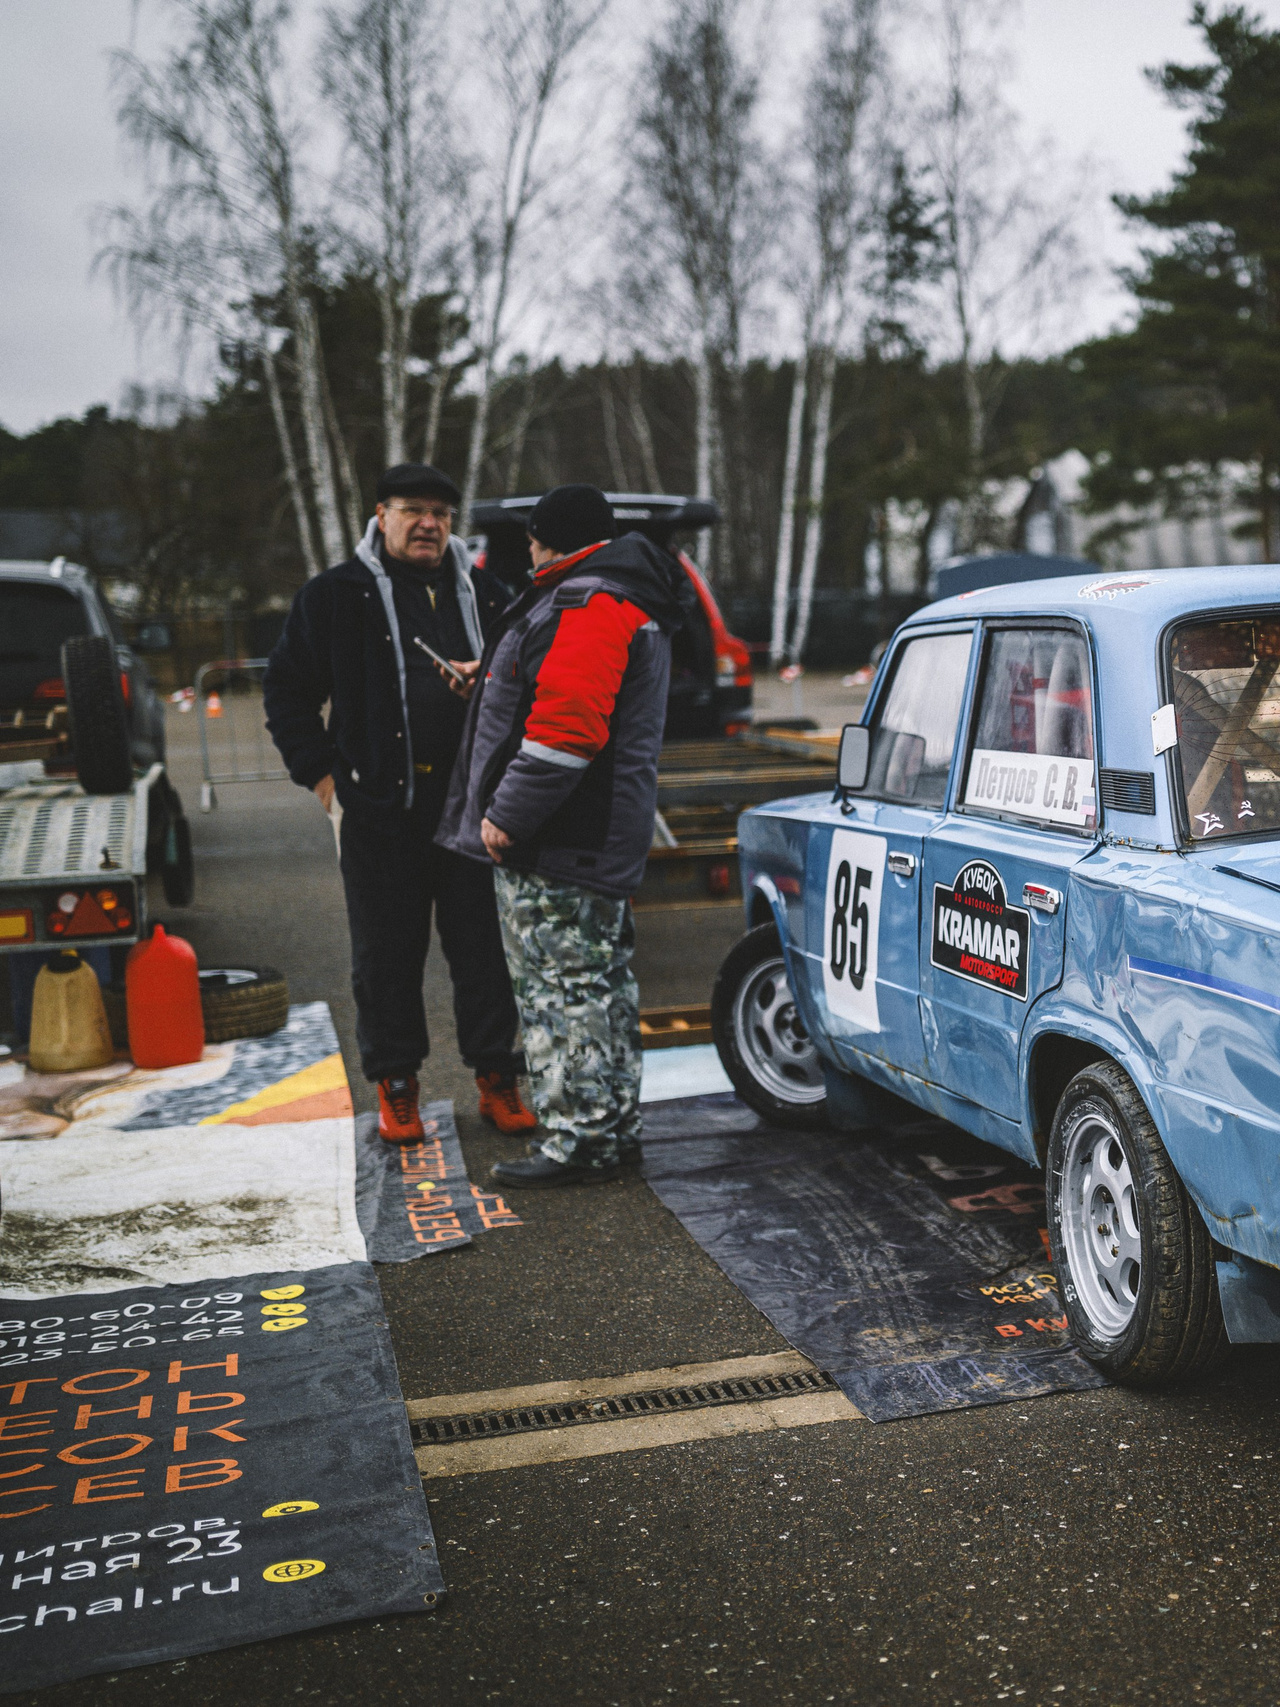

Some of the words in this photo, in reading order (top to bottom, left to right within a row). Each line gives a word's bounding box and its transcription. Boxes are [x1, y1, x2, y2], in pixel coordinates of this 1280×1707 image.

[975, 757, 1038, 805] Петров
[963, 866, 998, 900] КУБОК
[964, 896, 1004, 916] АВТОКРОССУ
[831, 860, 872, 990] 85
[938, 905, 1020, 970] KRAMAR
[960, 953, 1019, 988] MOTORSPORT
[404, 1186, 465, 1243] БЕТОН
[994, 1324, 1023, 1338] В
[12, 1552, 141, 1590] ная
[166, 1529, 243, 1565] 23
[0, 1576, 240, 1633] chal.ru
